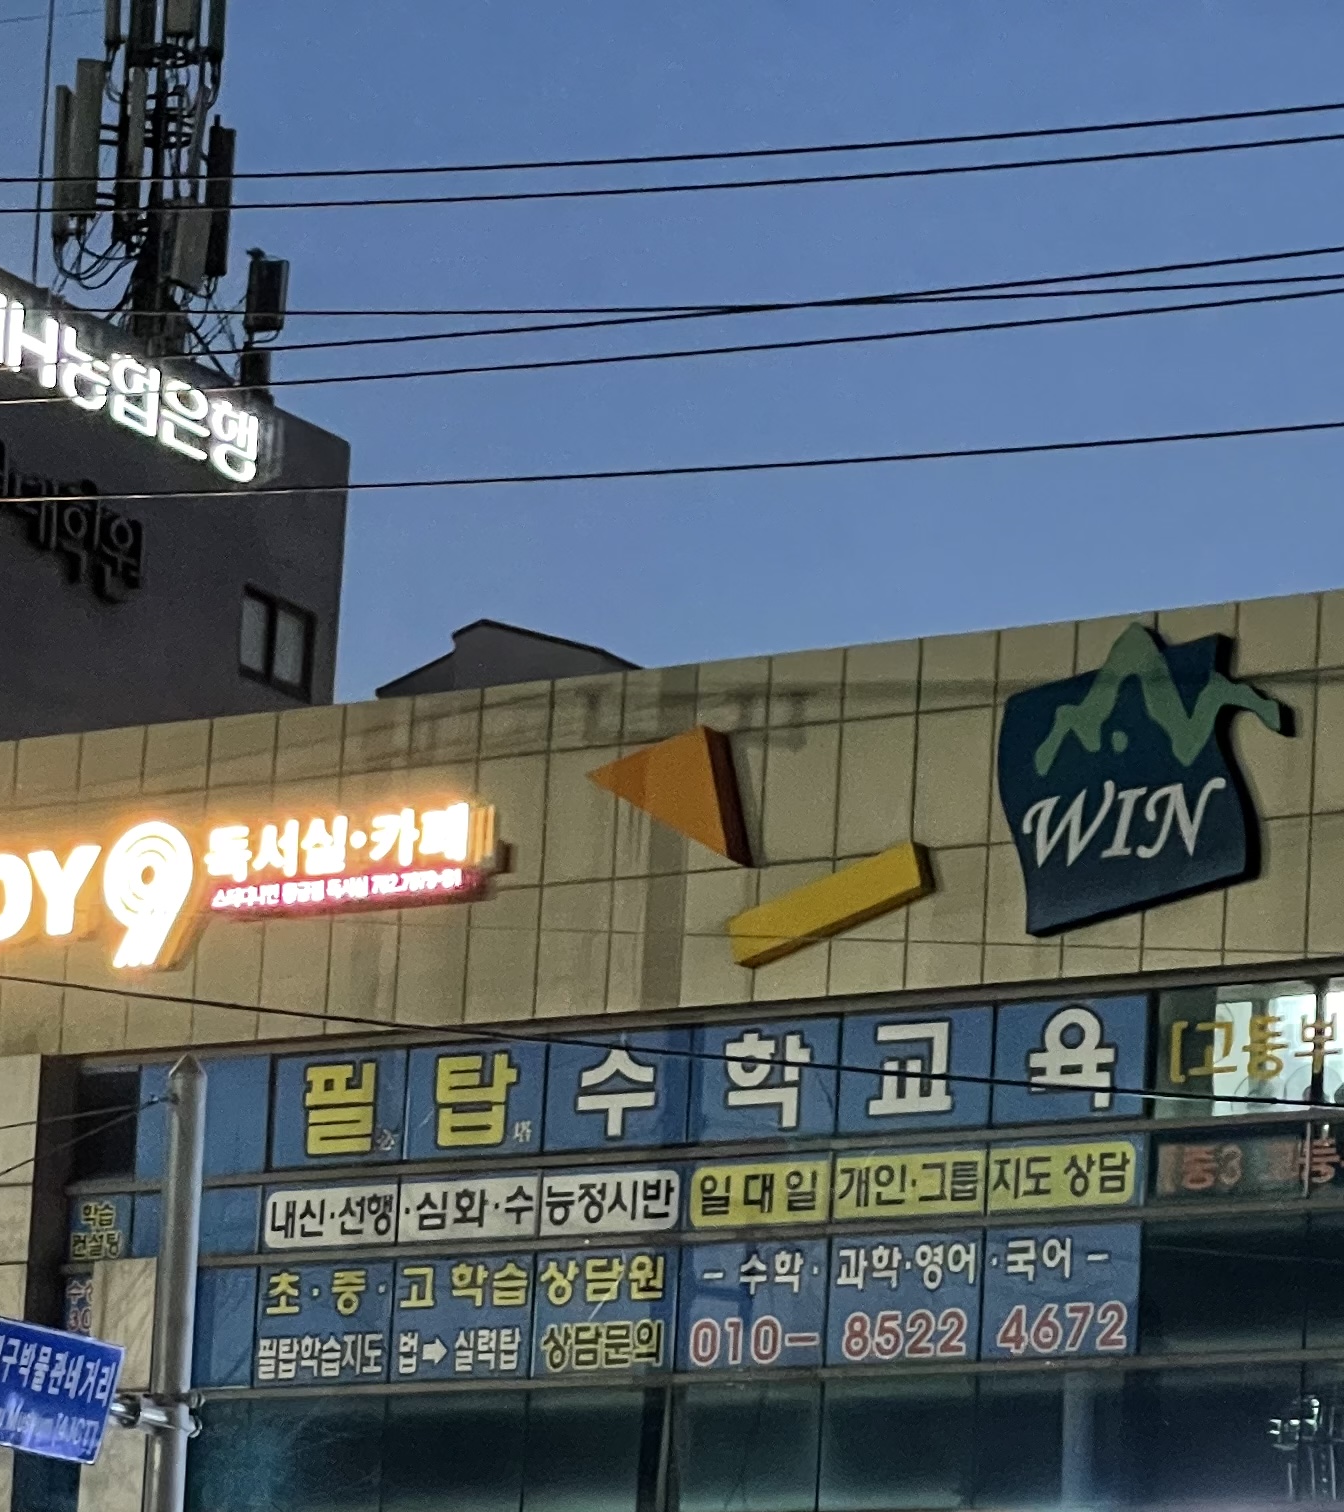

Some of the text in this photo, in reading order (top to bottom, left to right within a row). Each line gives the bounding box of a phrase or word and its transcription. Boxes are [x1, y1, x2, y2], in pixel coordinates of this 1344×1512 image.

[1023, 777, 1226, 868] WIN
[1064, 1151, 1129, 1197] 상담
[82, 1202, 116, 1228] 학습
[71, 1232, 122, 1259] 컨설팅
[541, 1319, 662, 1371] 상담문의
[842, 1308, 967, 1362] 8522
[996, 1301, 1128, 1353] 4672
